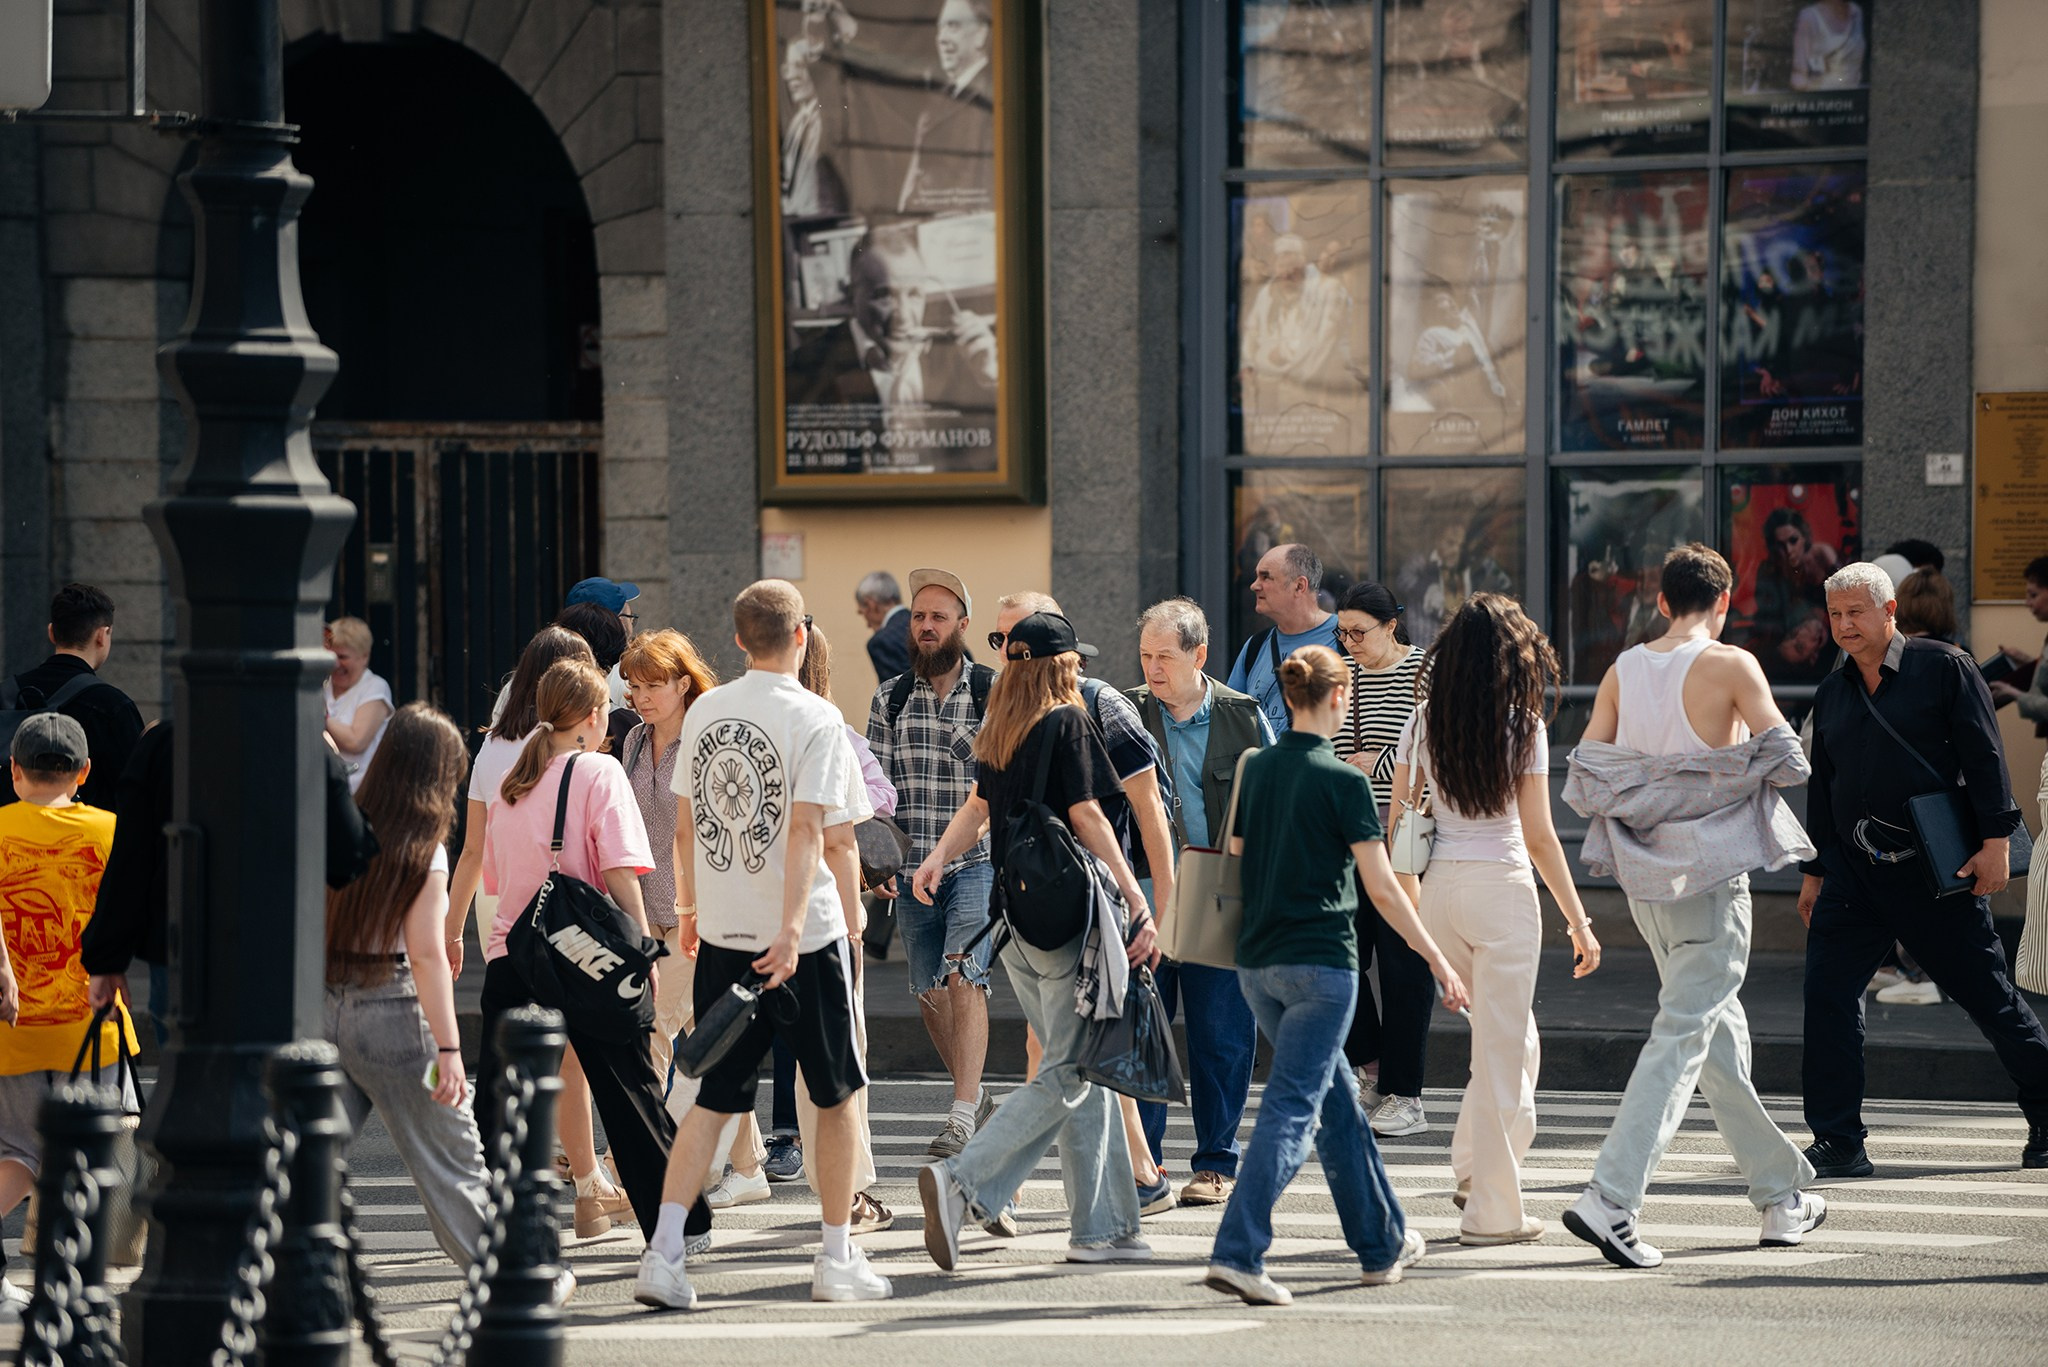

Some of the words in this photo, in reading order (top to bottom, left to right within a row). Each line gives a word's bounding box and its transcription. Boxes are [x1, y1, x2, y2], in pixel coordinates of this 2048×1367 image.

[1602, 106, 1681, 122] ПИГМАЛИОН
[1771, 99, 1853, 114] ПИГМАЛИОН
[1771, 407, 1799, 422] ДОН
[1802, 406, 1847, 420] КИХОТ
[1617, 418, 1669, 432] ГАМЛЕТ
[787, 430, 877, 452] РУДОЛЬФ
[879, 428, 992, 448] ФУРМАНОВ
[547, 924, 626, 982] NIKE
